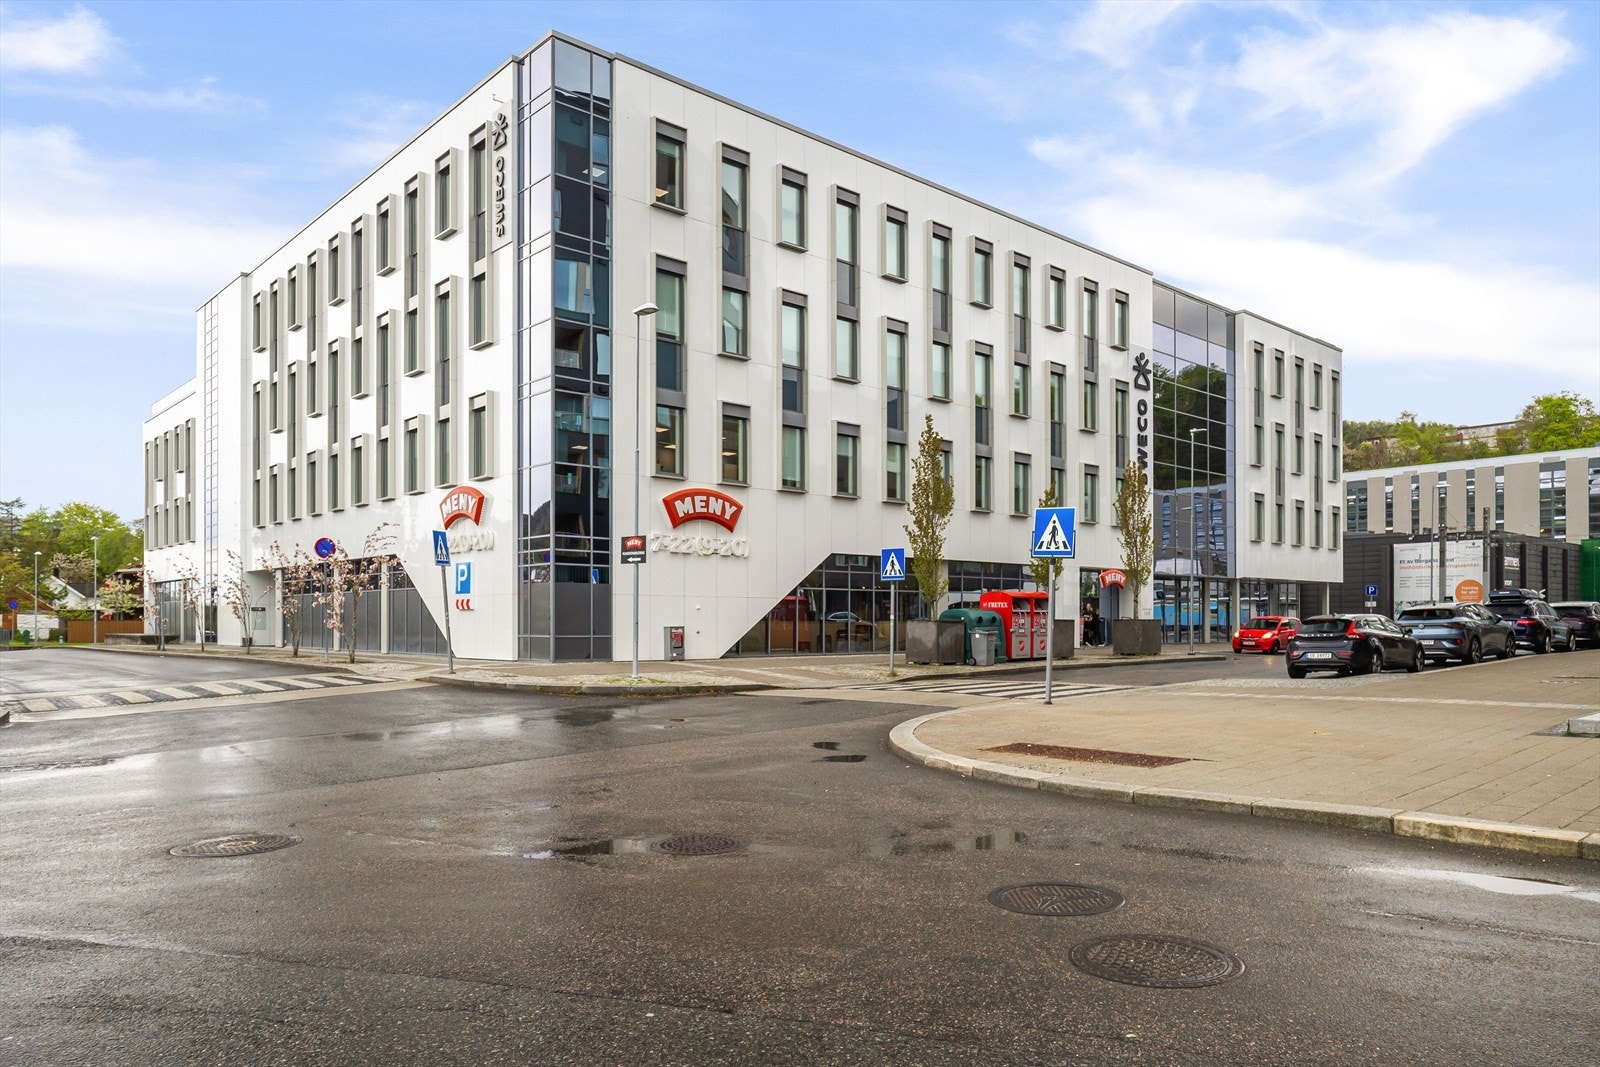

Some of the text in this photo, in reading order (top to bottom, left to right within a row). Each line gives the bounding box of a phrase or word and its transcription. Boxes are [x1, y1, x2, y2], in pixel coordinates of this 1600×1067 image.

[495, 155, 505, 237] SWECO
[441, 493, 477, 519] MENY
[674, 495, 738, 520] MENY
[626, 539, 642, 548] MENY
[457, 564, 468, 592] P
[1105, 573, 1126, 583] MENY
[1368, 586, 1375, 594] P
